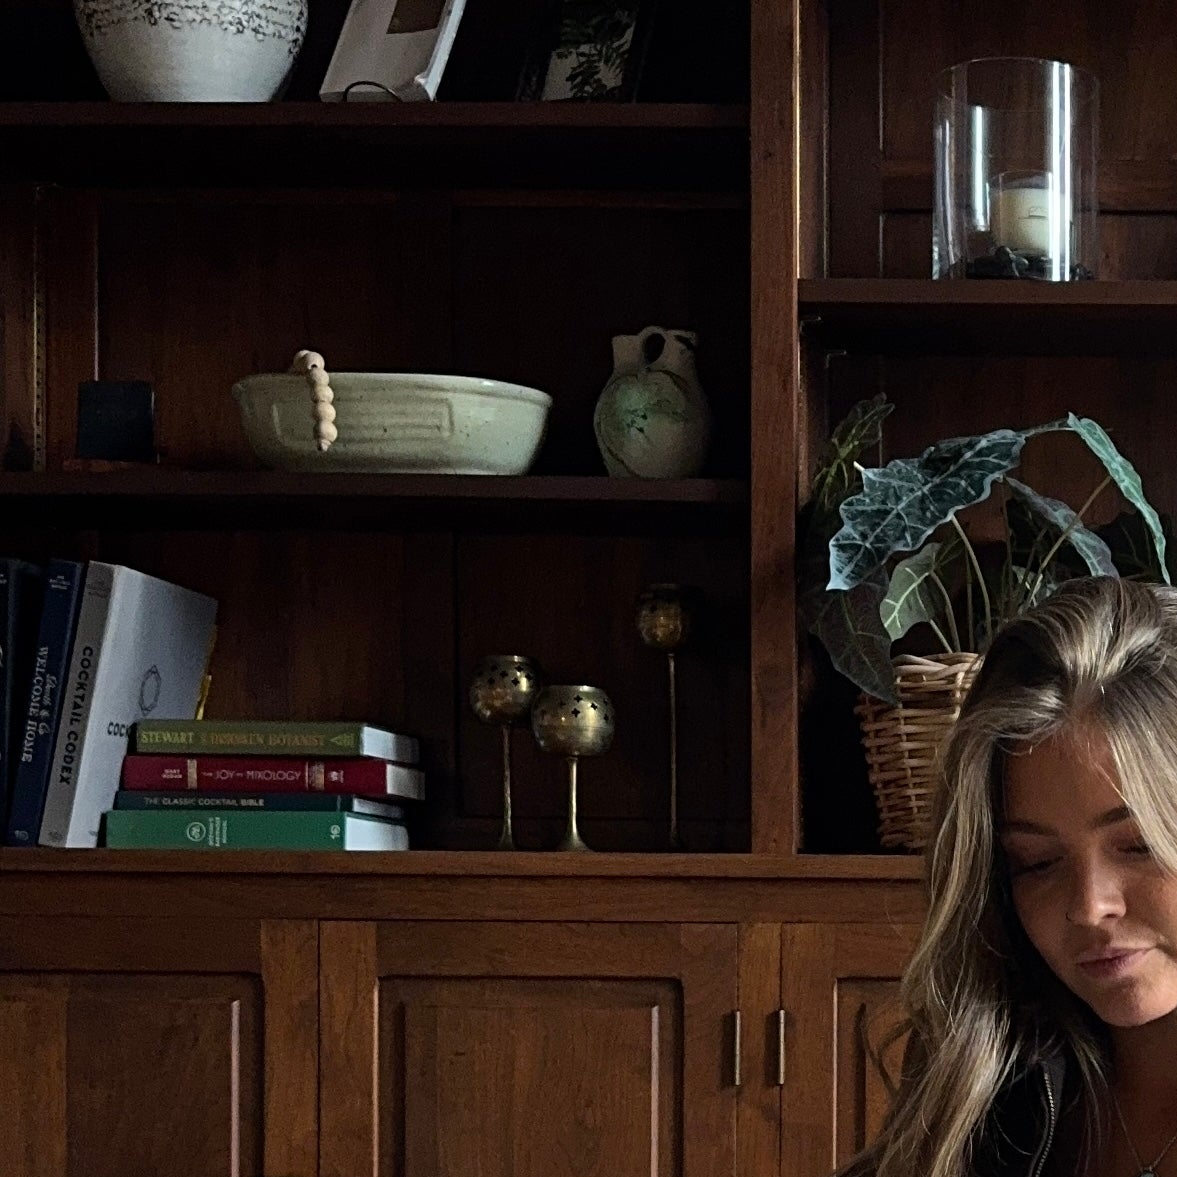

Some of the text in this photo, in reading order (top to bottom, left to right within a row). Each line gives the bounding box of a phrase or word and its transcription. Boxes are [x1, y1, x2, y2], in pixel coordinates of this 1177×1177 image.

[21, 646, 49, 763] WELCOME HOME
[59, 646, 94, 786] COCKTAIL CODEX
[141, 730, 195, 744] STEWART
[215, 769, 236, 780] JOY
[246, 769, 302, 781] MIXOLOGY
[144, 797, 158, 805] THE
[162, 797, 196, 806] CLASSIC
[198, 798, 238, 807] COCKTAIL
